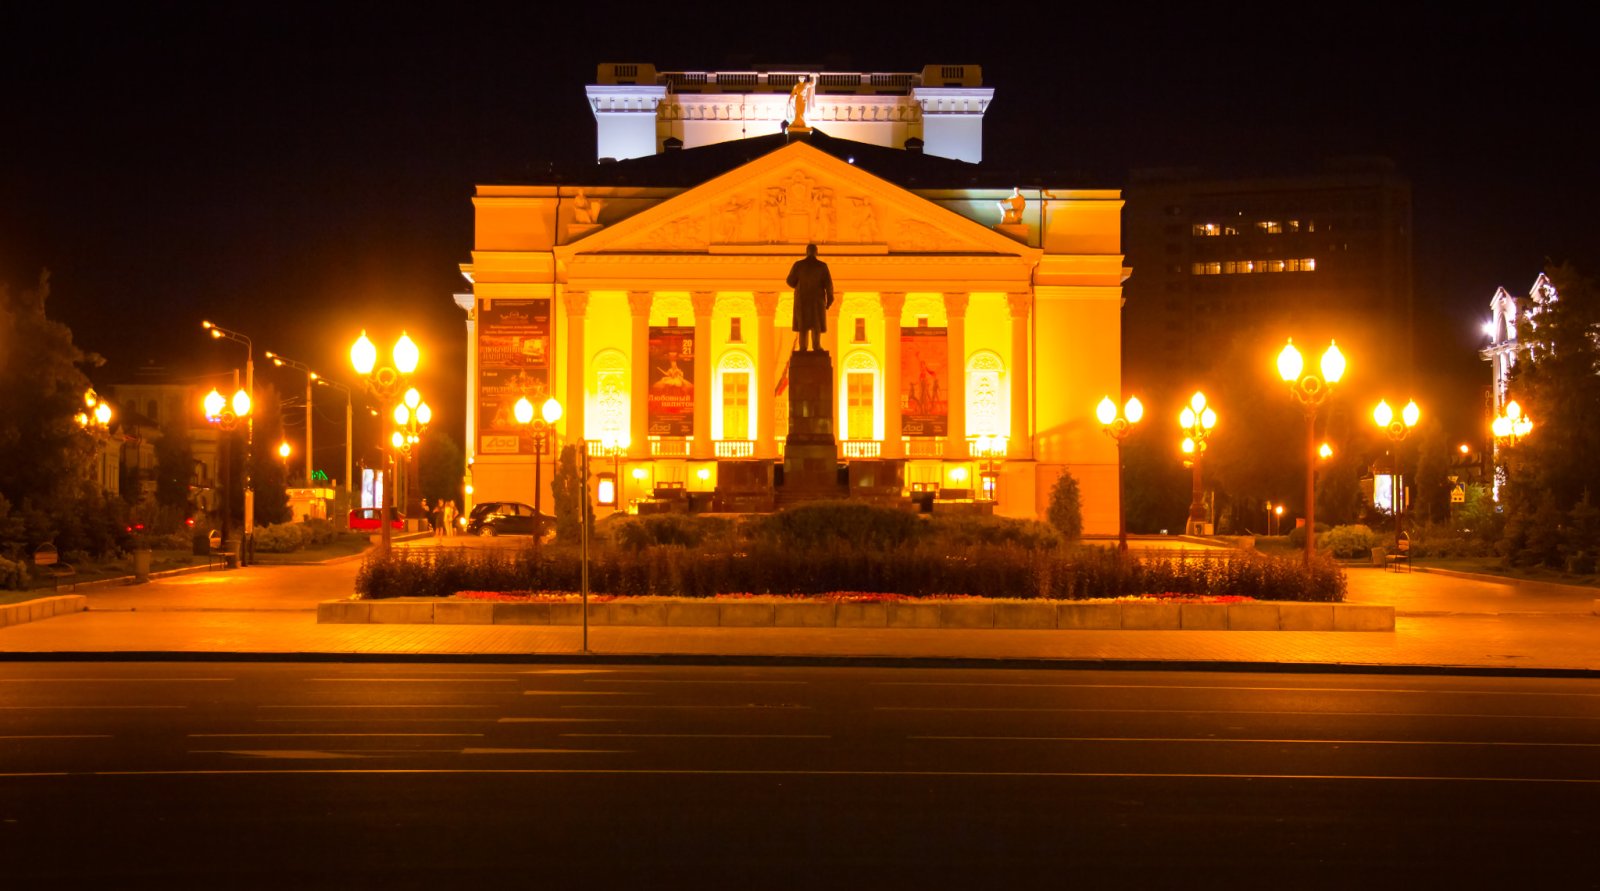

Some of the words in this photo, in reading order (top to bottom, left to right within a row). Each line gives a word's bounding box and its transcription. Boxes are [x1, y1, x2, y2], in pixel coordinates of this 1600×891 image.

[682, 339, 693, 347] 20
[682, 347, 692, 355] 21
[648, 394, 691, 402] Любовный
